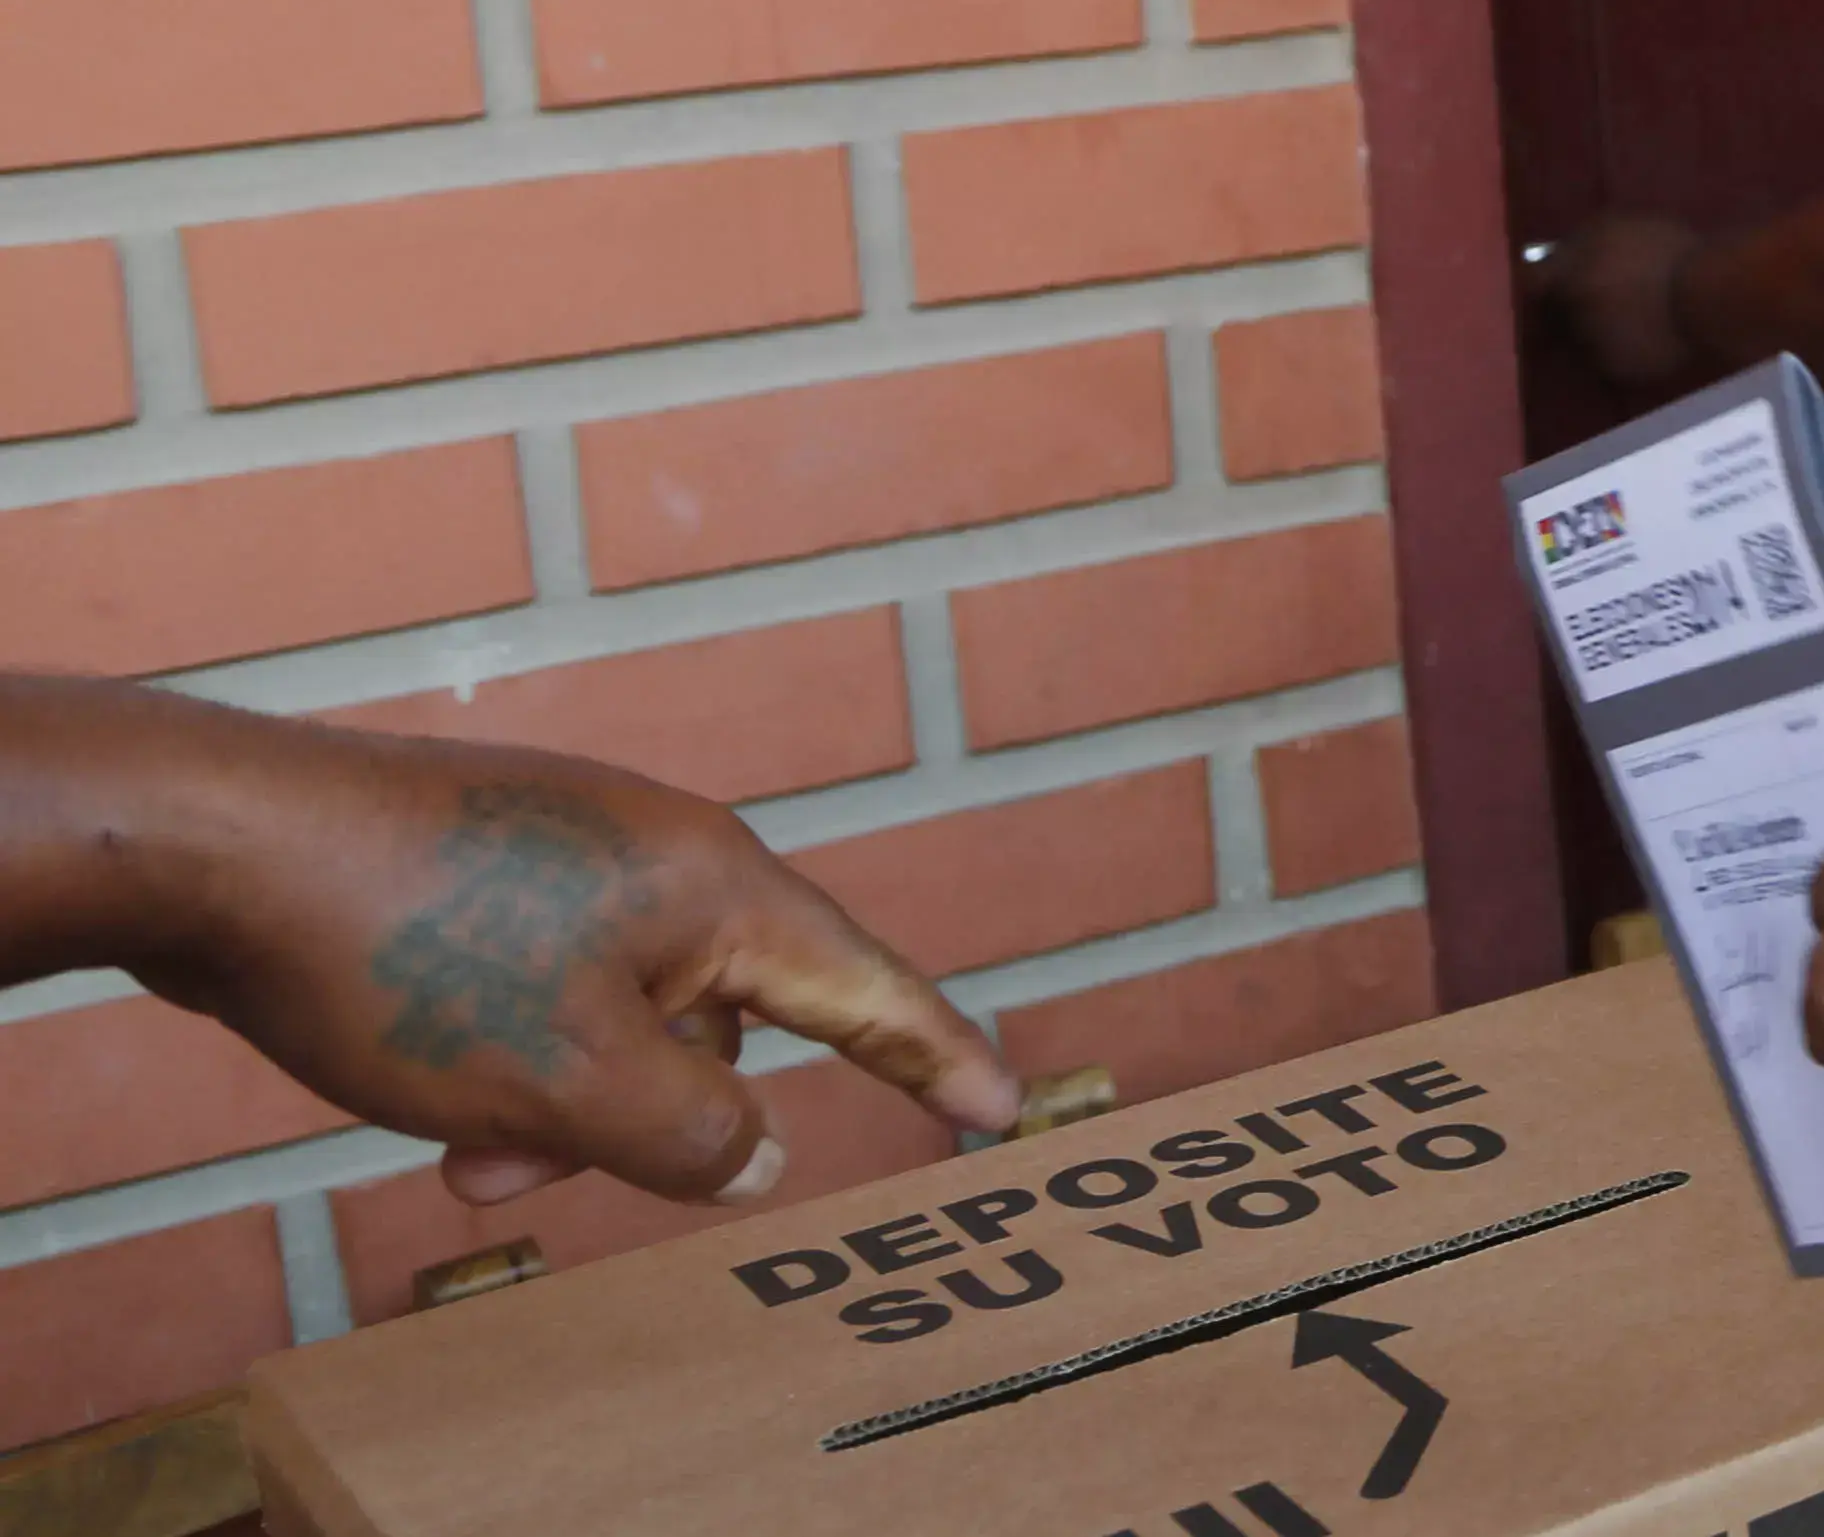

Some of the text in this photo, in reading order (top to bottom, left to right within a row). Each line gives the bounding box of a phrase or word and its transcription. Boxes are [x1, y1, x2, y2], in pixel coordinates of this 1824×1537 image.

[729, 1060, 1489, 1308] DEPOSITE
[838, 1123, 1507, 1344] SU VOTO
